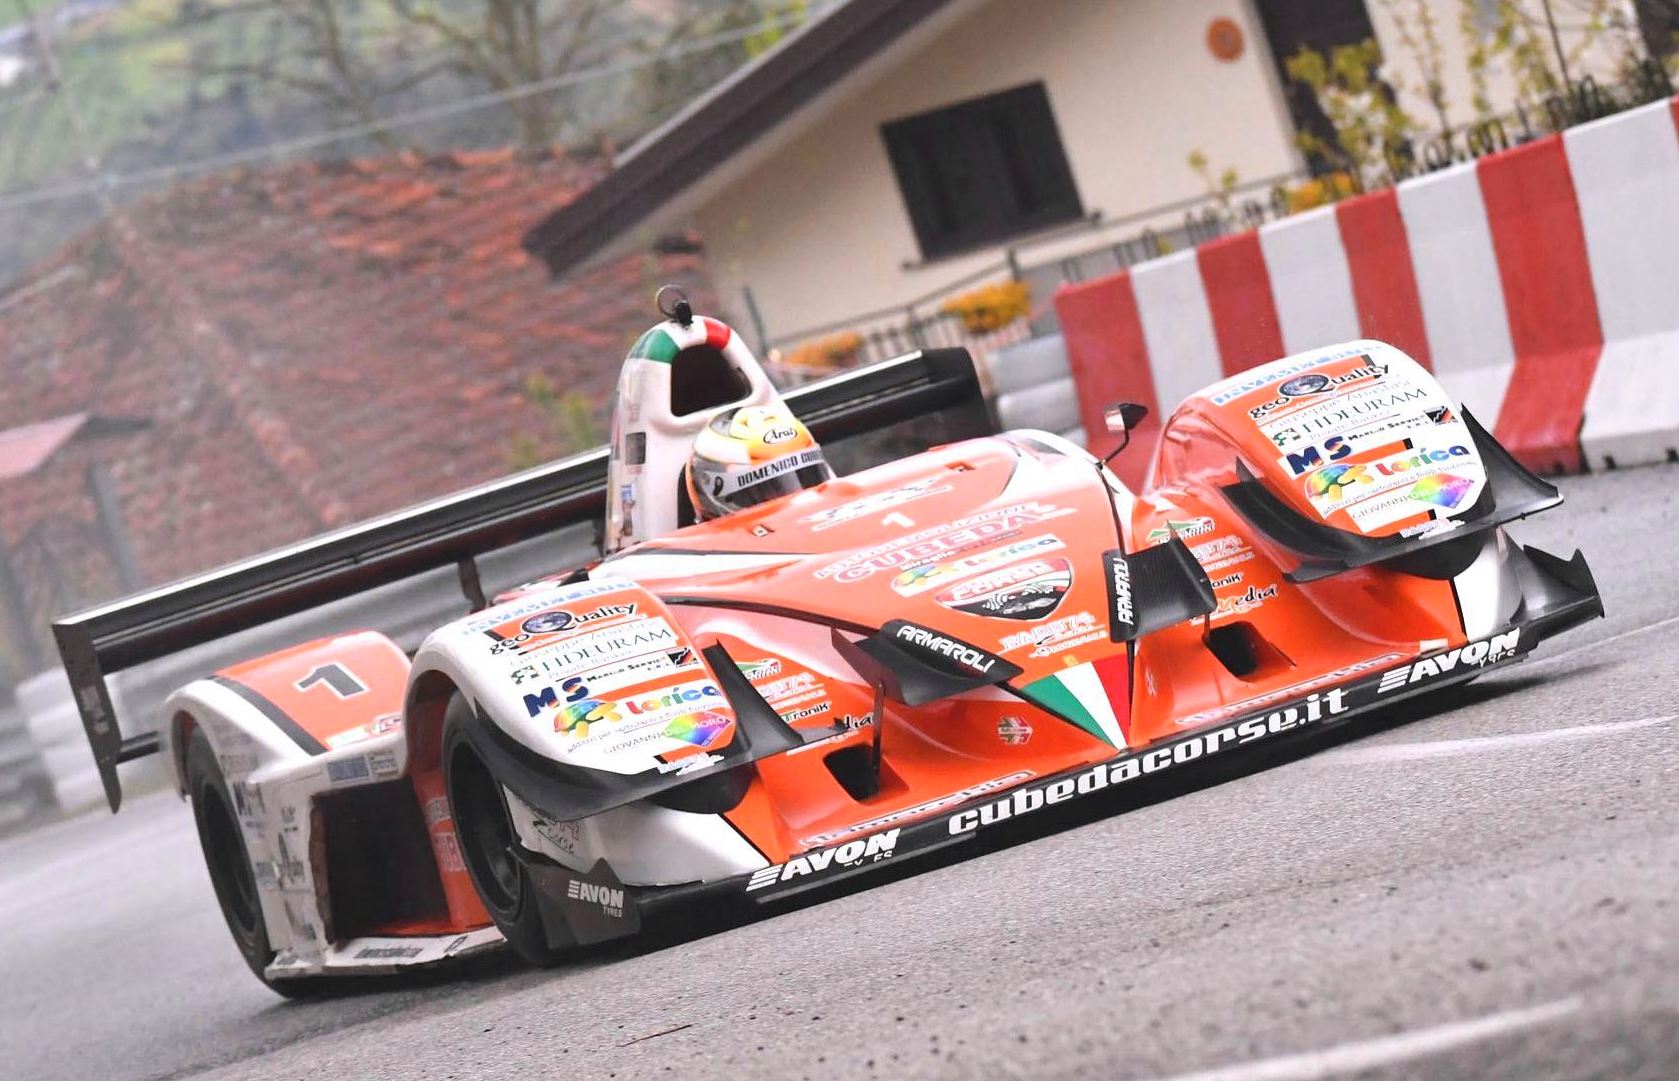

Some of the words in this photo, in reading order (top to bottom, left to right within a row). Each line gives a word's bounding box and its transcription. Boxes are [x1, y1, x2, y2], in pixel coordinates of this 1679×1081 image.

[737, 454, 799, 487] DOMENICO
[1286, 436, 1353, 476] MS
[835, 510, 1045, 582] CUBEDA
[1112, 557, 1134, 626] ARMAROLI
[896, 624, 997, 674] ARMAROLI
[1409, 627, 1520, 684] AVON
[294, 661, 370, 700] 1
[522, 676, 589, 718] MS
[947, 688, 1351, 836] cubedacorse.it
[780, 828, 901, 881] AVON
[579, 883, 624, 909] AVON
